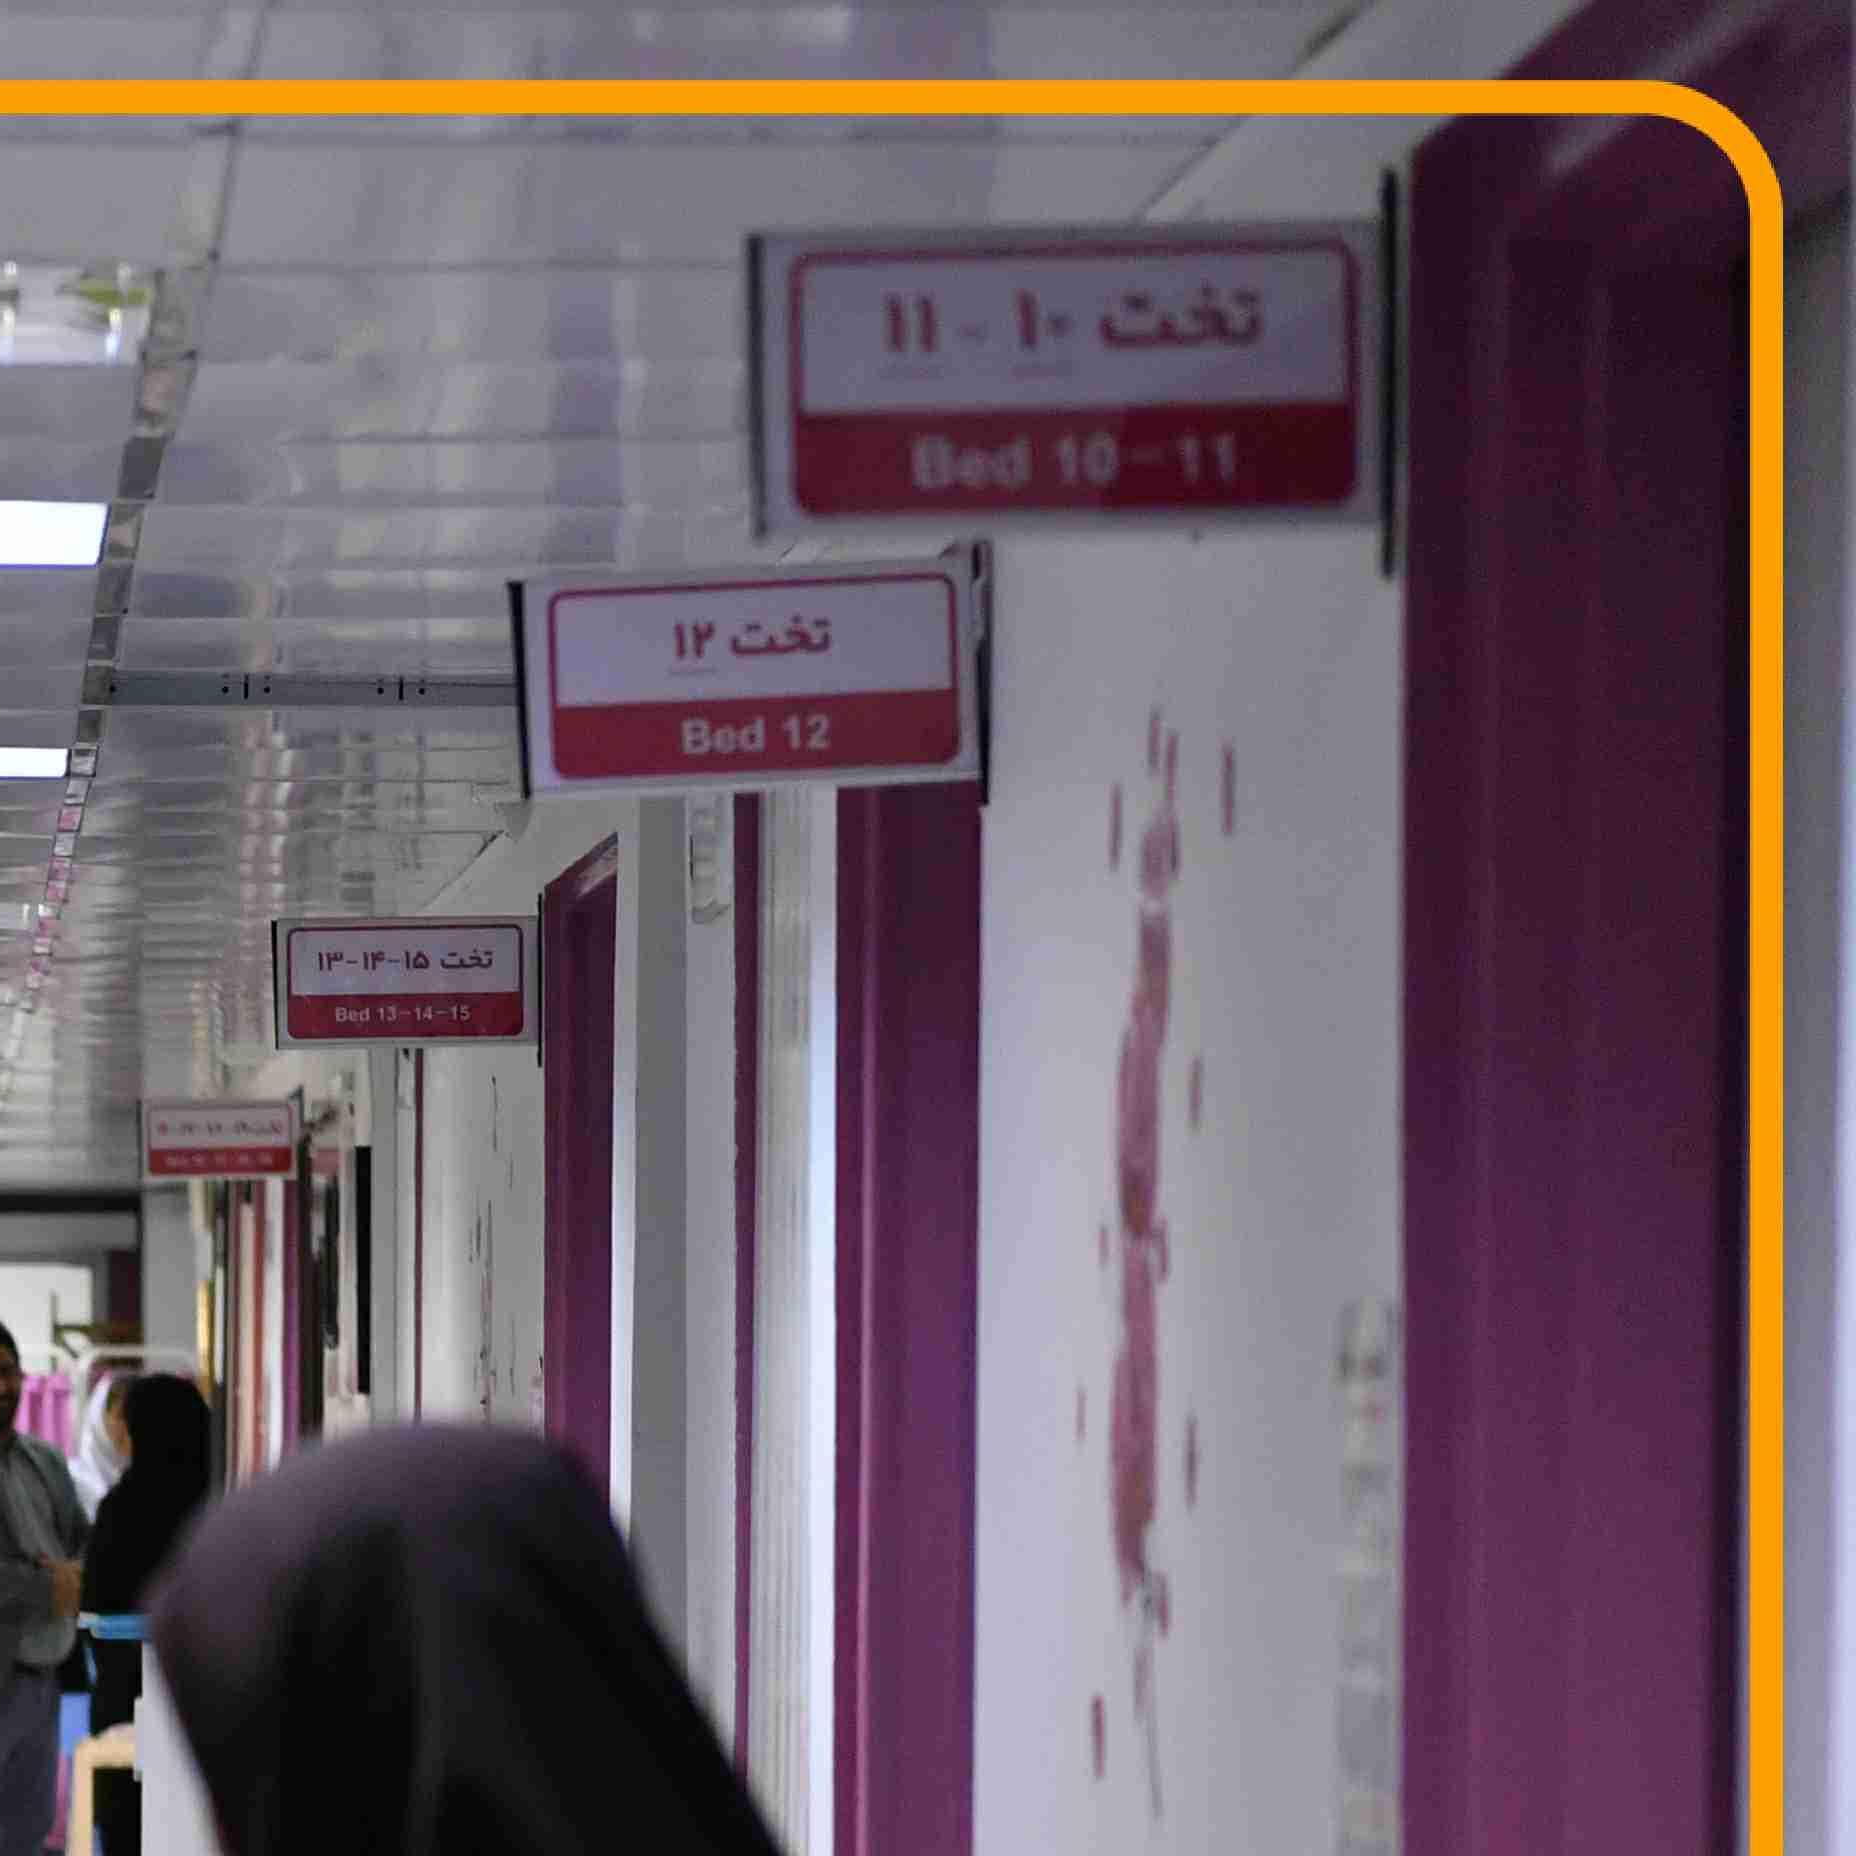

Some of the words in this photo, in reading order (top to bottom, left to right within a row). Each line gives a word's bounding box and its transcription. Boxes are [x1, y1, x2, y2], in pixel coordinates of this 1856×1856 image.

[1097, 278, 1268, 349] تخت
[910, 433, 1033, 490] Bed
[672, 619, 717, 660] ۱۲
[729, 614, 833, 657] تخت
[681, 717, 766, 755] Bed
[783, 713, 831, 751] 12
[440, 948, 494, 971] تخت
[334, 1006, 371, 1023] Bed
